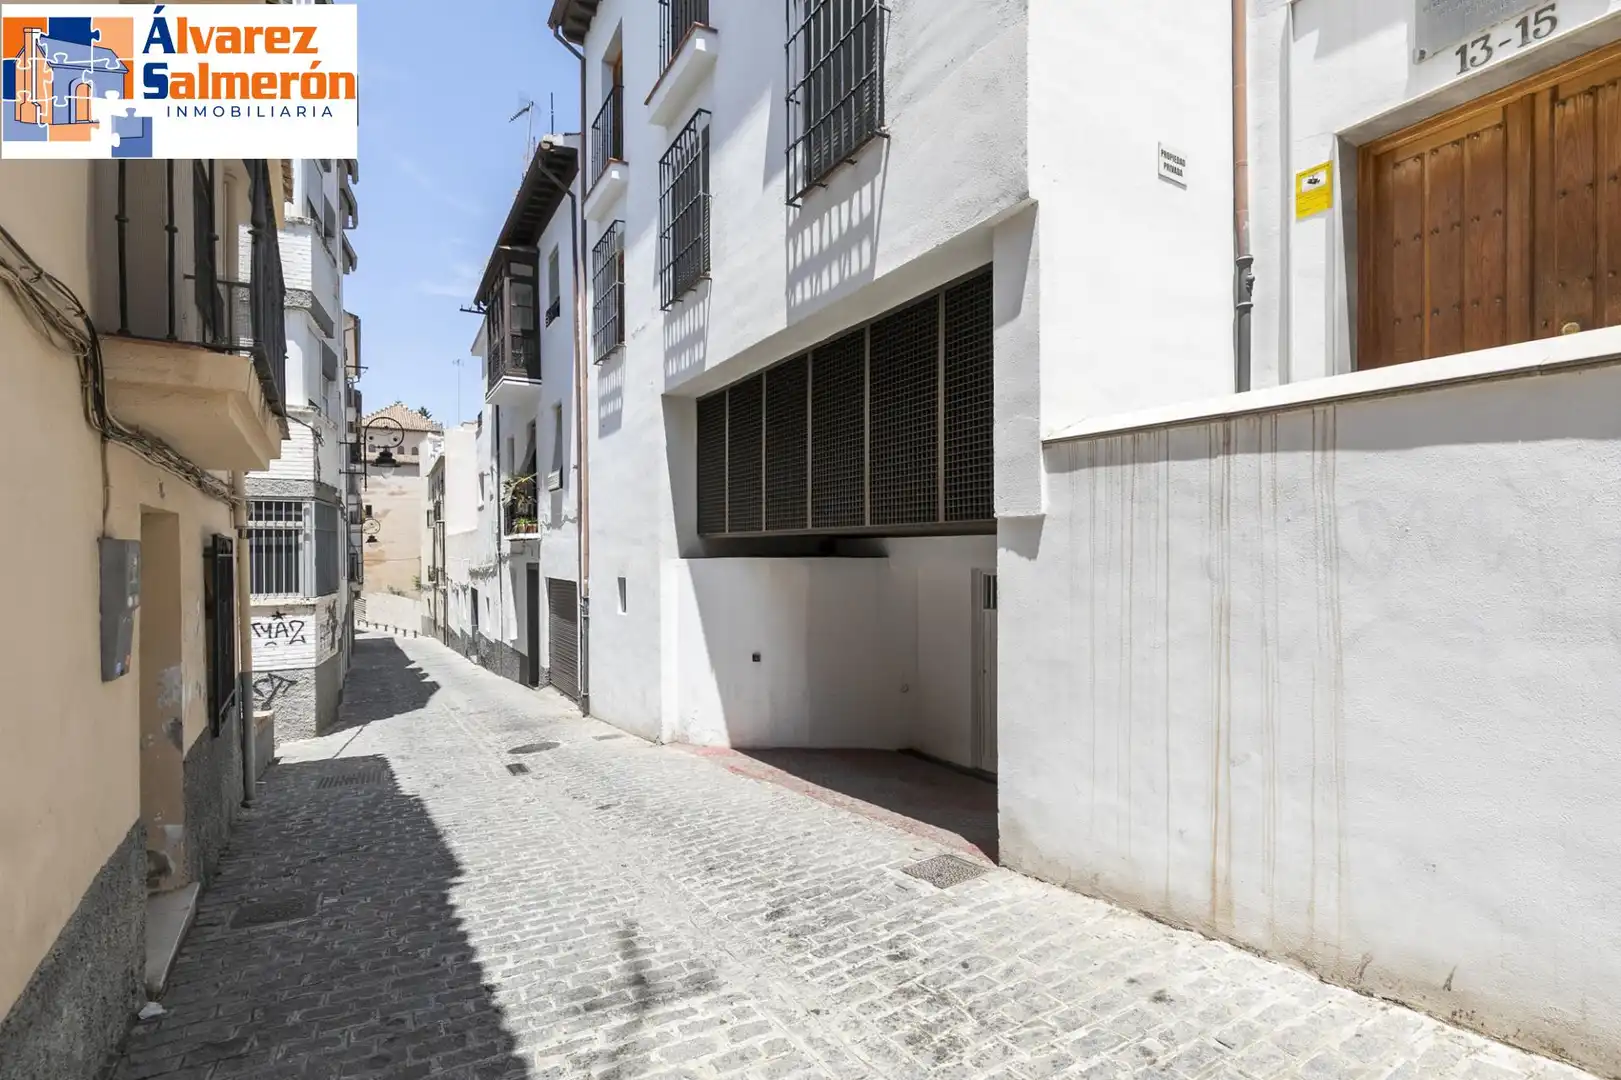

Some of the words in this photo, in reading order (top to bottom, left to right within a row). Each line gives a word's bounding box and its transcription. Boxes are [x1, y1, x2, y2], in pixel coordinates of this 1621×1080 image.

[1455, 4, 1558, 75] 13-15
[1160, 149, 1186, 167] PROPIEDAD
[1163, 162, 1183, 177] PRIVADA
